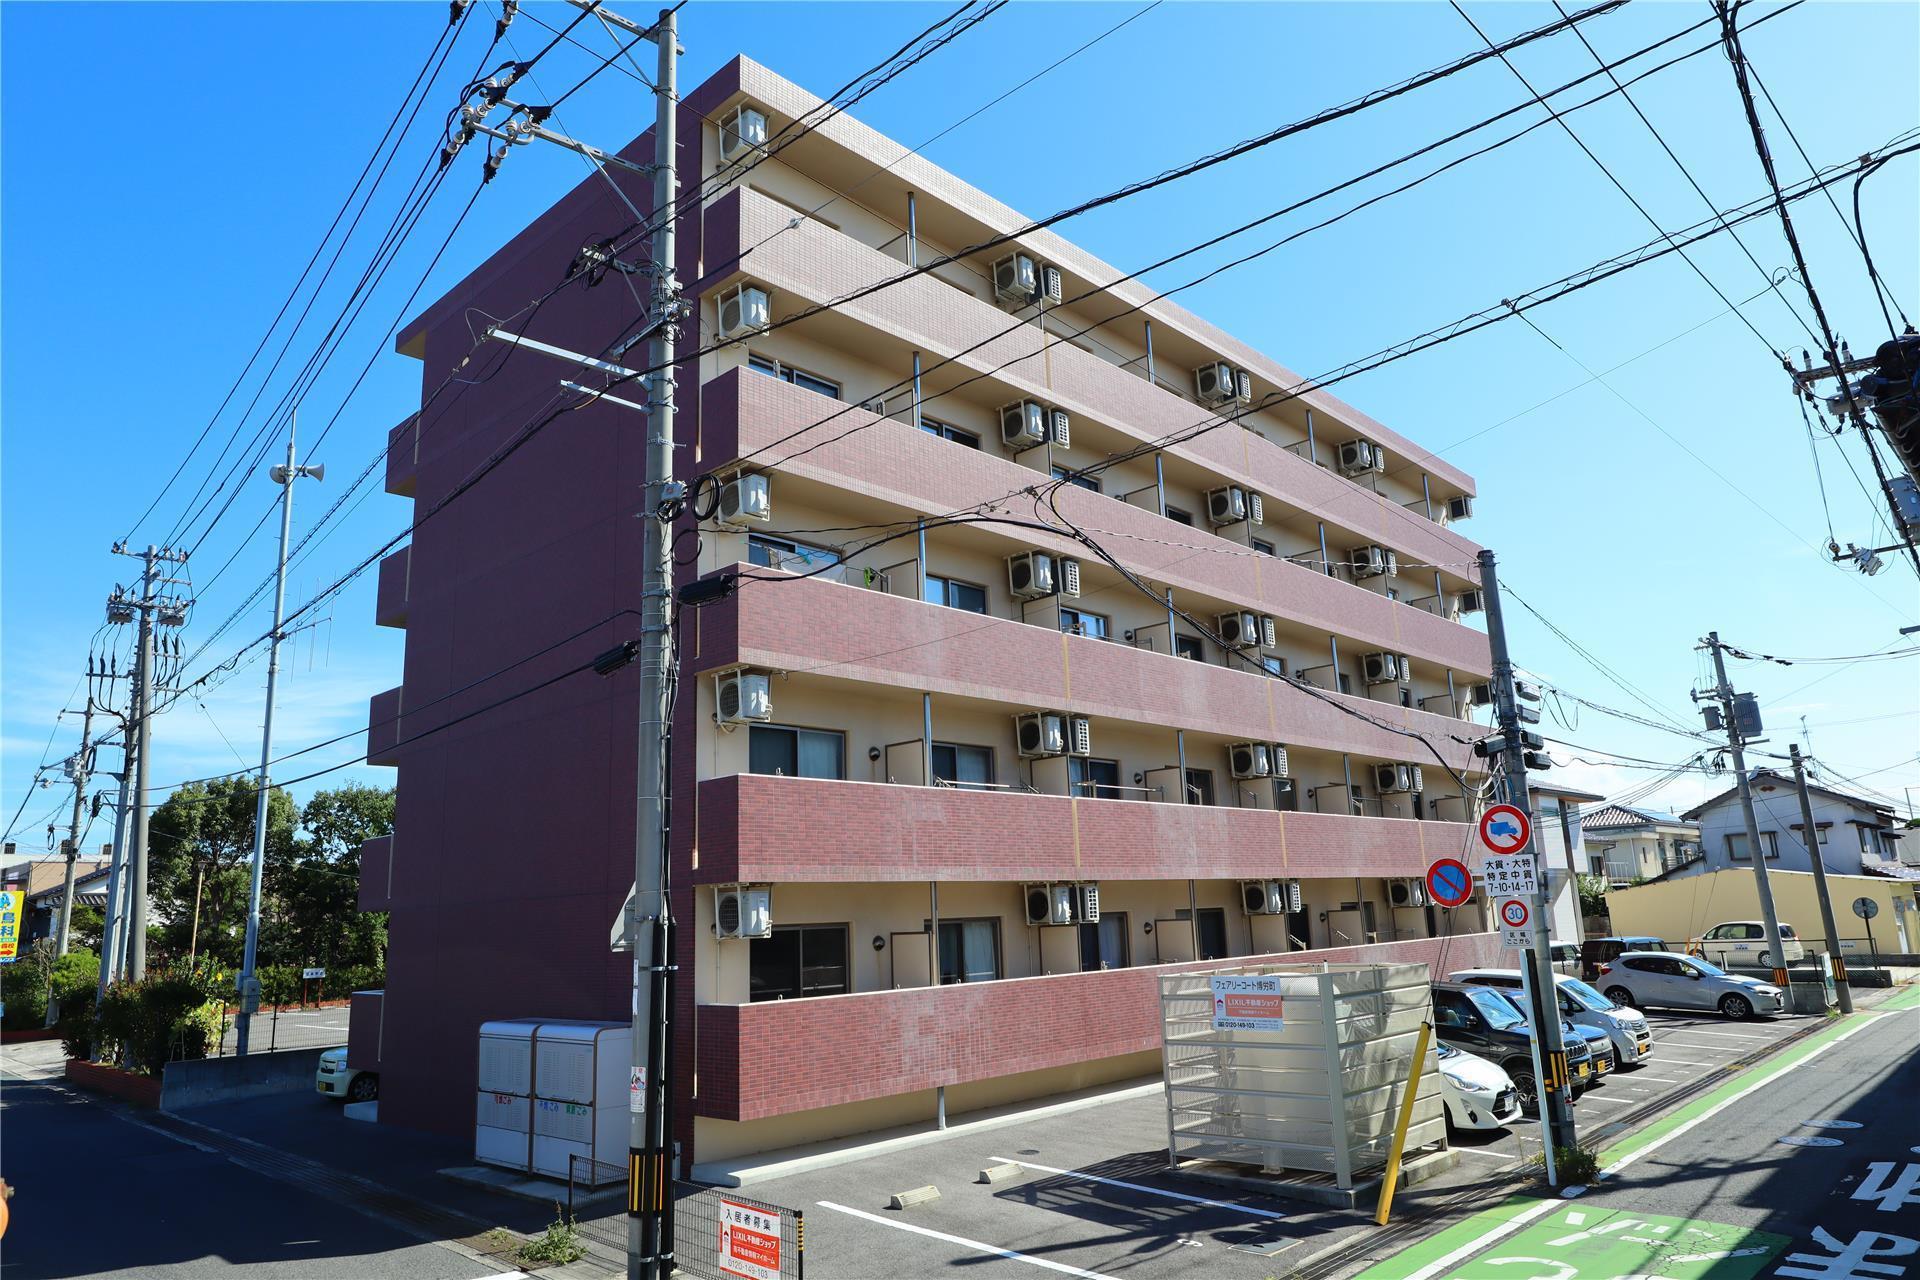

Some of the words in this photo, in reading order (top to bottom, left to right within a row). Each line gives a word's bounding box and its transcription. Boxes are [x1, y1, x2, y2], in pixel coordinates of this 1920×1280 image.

[1486, 870, 1533, 881] 特定中貨
[1507, 907, 1523, 920] 30
[725, 1208, 771, 1231] 入居者募集
